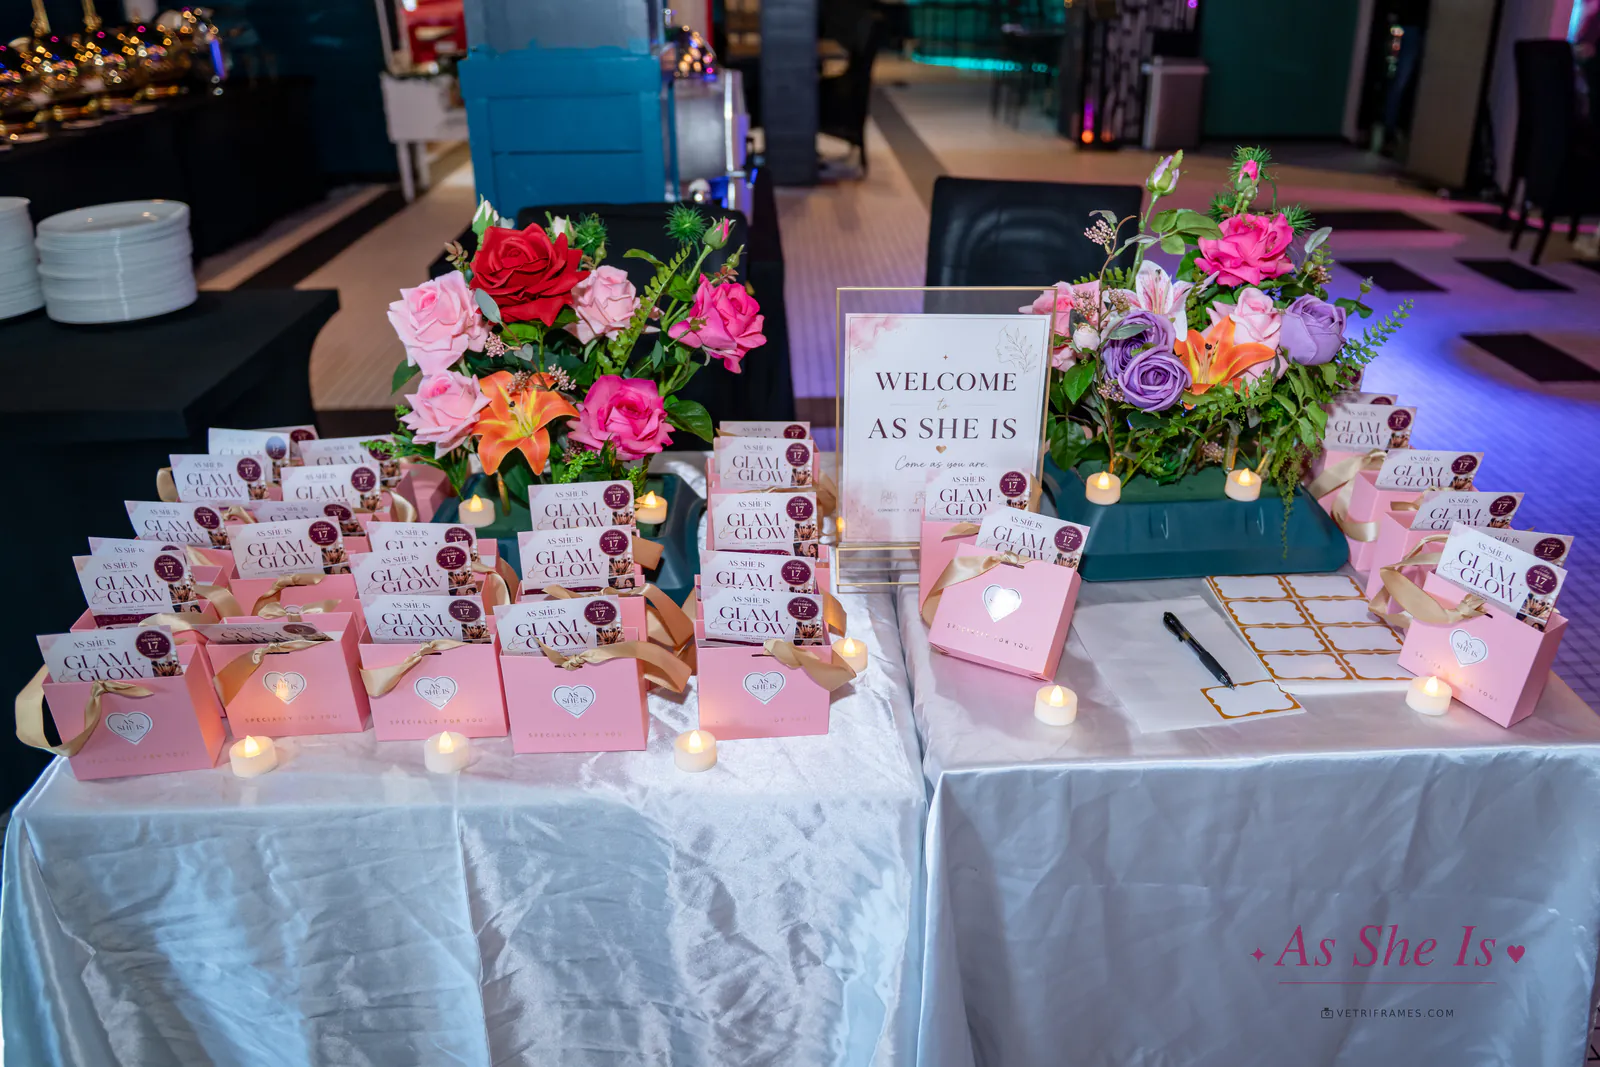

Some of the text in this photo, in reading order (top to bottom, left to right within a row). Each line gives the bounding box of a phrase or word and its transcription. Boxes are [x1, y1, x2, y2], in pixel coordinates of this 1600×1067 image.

[876, 372, 1017, 392] WELCOME
[937, 398, 949, 410] to
[868, 418, 1017, 440] AS SHE IS
[1335, 421, 1380, 434] GLAM
[1338, 434, 1380, 445] GLOW
[733, 455, 779, 469] GLAM
[895, 455, 989, 470] Come as you are.
[738, 470, 786, 482] GLOW
[1394, 465, 1443, 477] GLAM
[186, 473, 233, 485] GLAM
[1395, 477, 1442, 487] GLOW
[196, 486, 244, 498] GLOW
[296, 484, 345, 500] GLAM
[940, 489, 992, 502] GLAM
[545, 502, 597, 517] GLAM
[1430, 507, 1481, 520] GLAM
[144, 520, 193, 532] GLAM
[553, 515, 607, 530] GLOW
[727, 513, 779, 526] GLAM
[1020, 518, 1033, 526] SHE
[1035, 521, 1043, 529] IS
[156, 532, 204, 543] GLOW
[735, 527, 789, 539] GLOW
[994, 526, 1046, 550] GLAM
[247, 540, 304, 556] GLAM
[1477, 542, 1512, 562] AS SHE IS
[258, 552, 316, 569] GLOW
[536, 548, 593, 565] GLAM
[371, 565, 431, 582] GLAM
[545, 562, 604, 578] GLOW
[1459, 550, 1516, 586] GLAM
[95, 574, 152, 590] GLAM
[382, 576, 442, 593] GLOW
[716, 571, 773, 587] GLAM
[1460, 568, 1521, 602] GLOW
[1536, 576, 1547, 585] 17
[107, 588, 164, 604] GLOW
[382, 613, 444, 626] GLAM
[595, 610, 606, 618] 17
[720, 606, 779, 622] GLAM
[393, 626, 455, 637] GLOW
[515, 619, 578, 637] GLAM
[728, 620, 790, 635] GLOW
[107, 638, 116, 646] IS
[147, 642, 158, 650] 17
[526, 632, 590, 649] GLOW
[1465, 640, 1473, 648] AS
[1456, 642, 1478, 658] SHE IS
[64, 651, 131, 670] GLAM
[78, 665, 145, 682] GLOW
